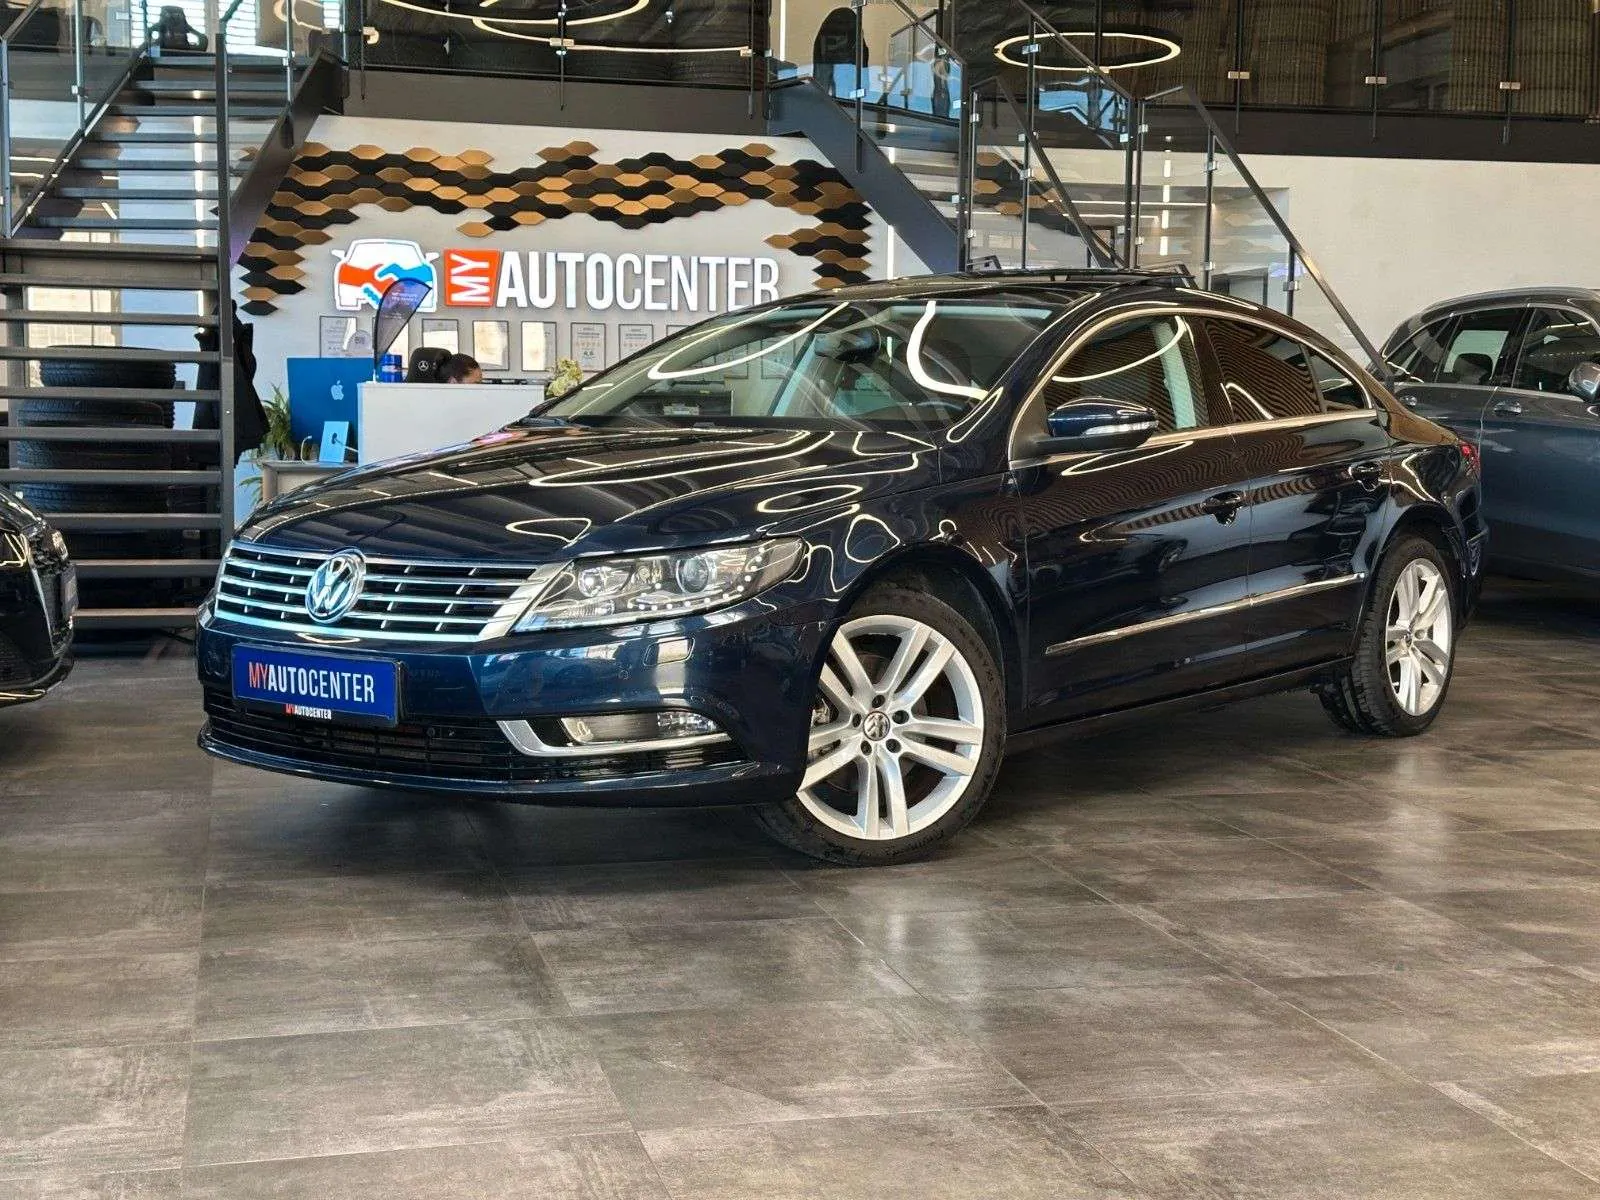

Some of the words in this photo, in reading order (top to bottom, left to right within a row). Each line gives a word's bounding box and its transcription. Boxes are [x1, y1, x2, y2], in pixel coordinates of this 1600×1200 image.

[450, 253, 491, 303] MY
[496, 250, 780, 312] AUTOCENTER
[248, 661, 375, 704] MYAUTOCENTER
[285, 703, 332, 720] MYAUTOCENTER
